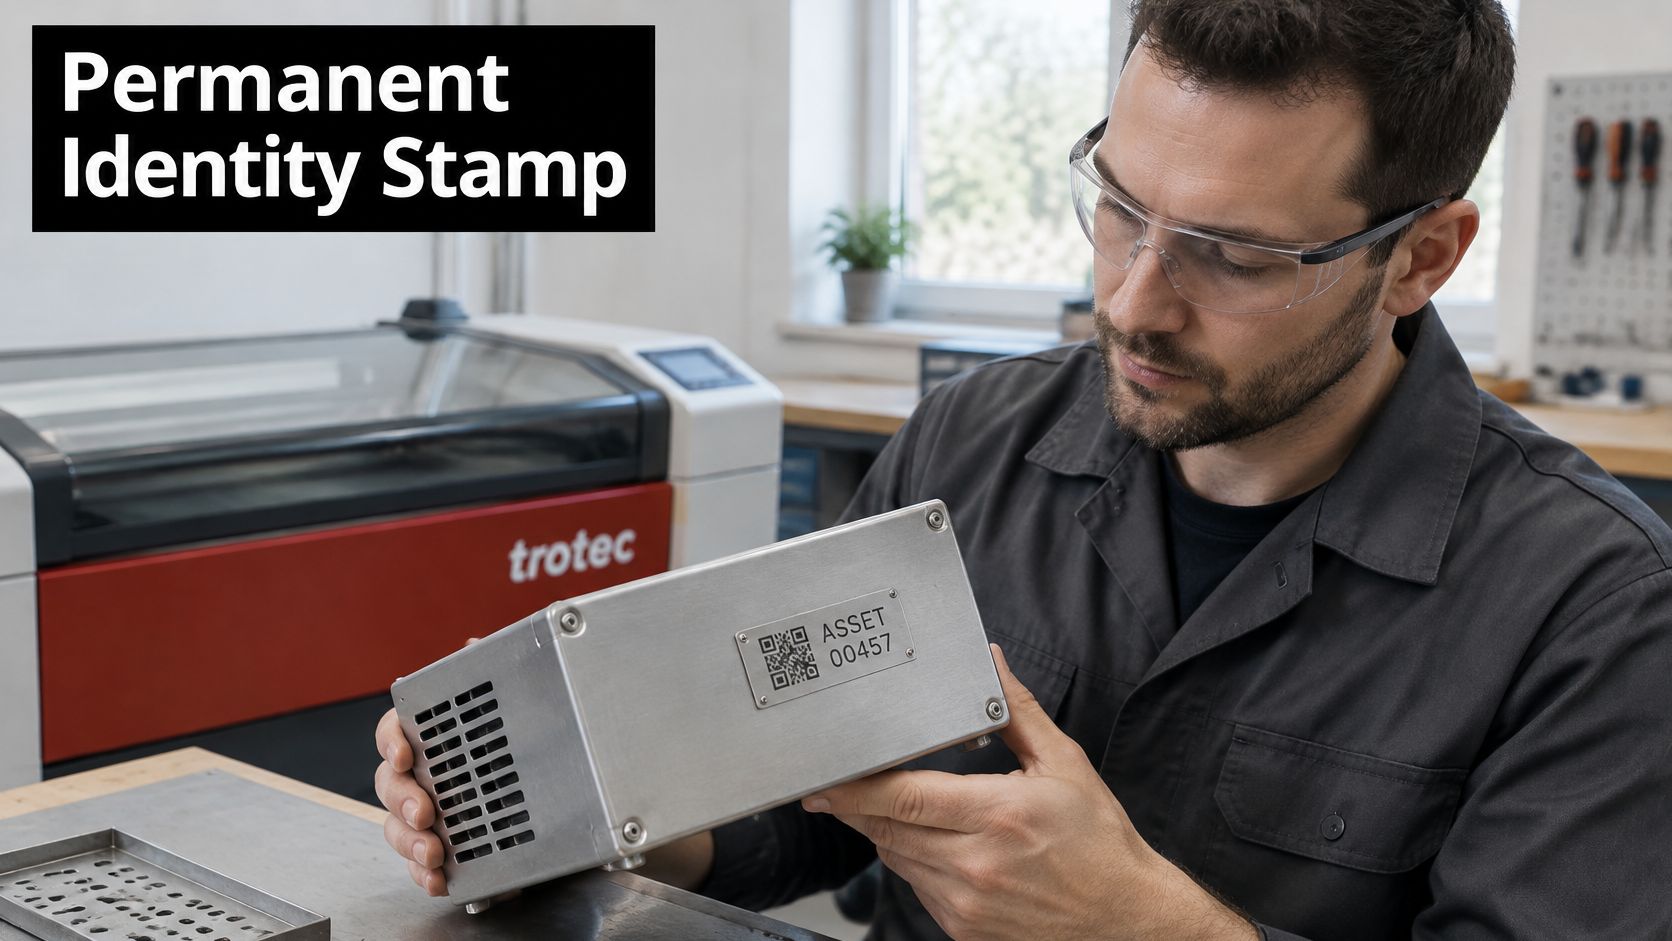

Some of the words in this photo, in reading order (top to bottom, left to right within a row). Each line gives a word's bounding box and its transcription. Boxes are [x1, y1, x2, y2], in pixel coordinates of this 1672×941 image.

[509, 529, 636, 583] trotec
[822, 607, 885, 643] ASSET
[829, 633, 891, 667] 00457
